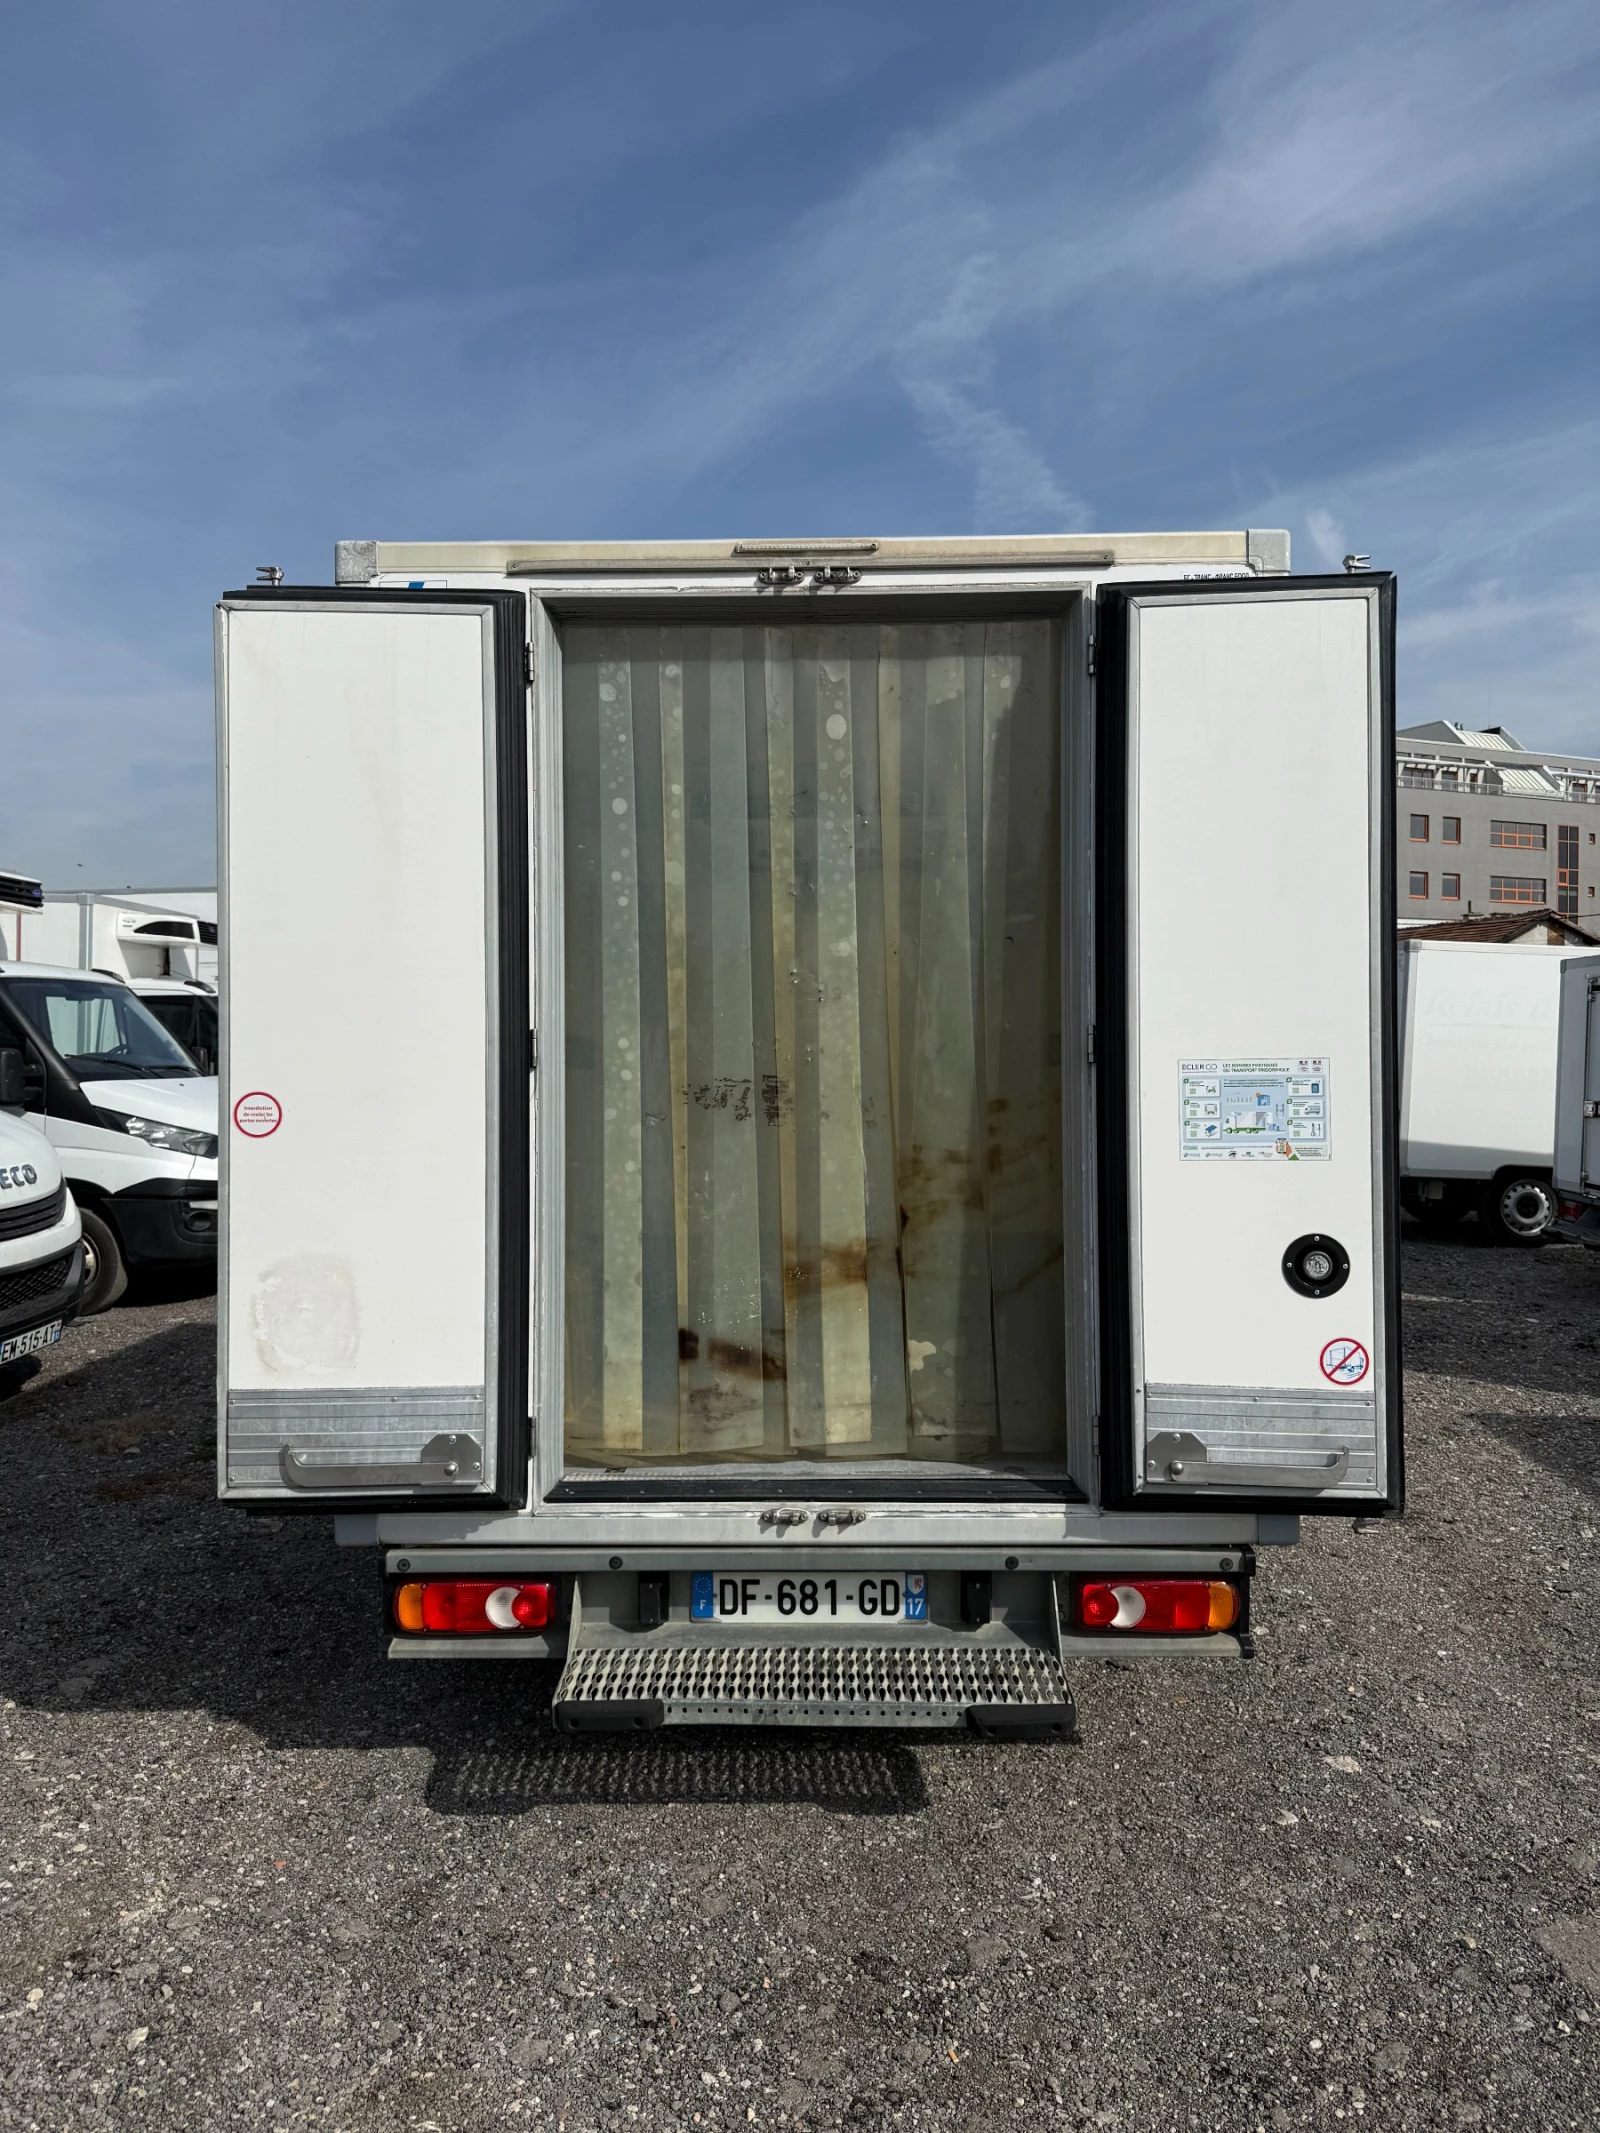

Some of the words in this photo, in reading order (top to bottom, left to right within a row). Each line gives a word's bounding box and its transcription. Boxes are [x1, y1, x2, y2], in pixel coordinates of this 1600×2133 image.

[700, 1600, 707, 1611] F
[719, 1579, 900, 1616] DF-681-GD
[907, 1598, 924, 1616] 17
